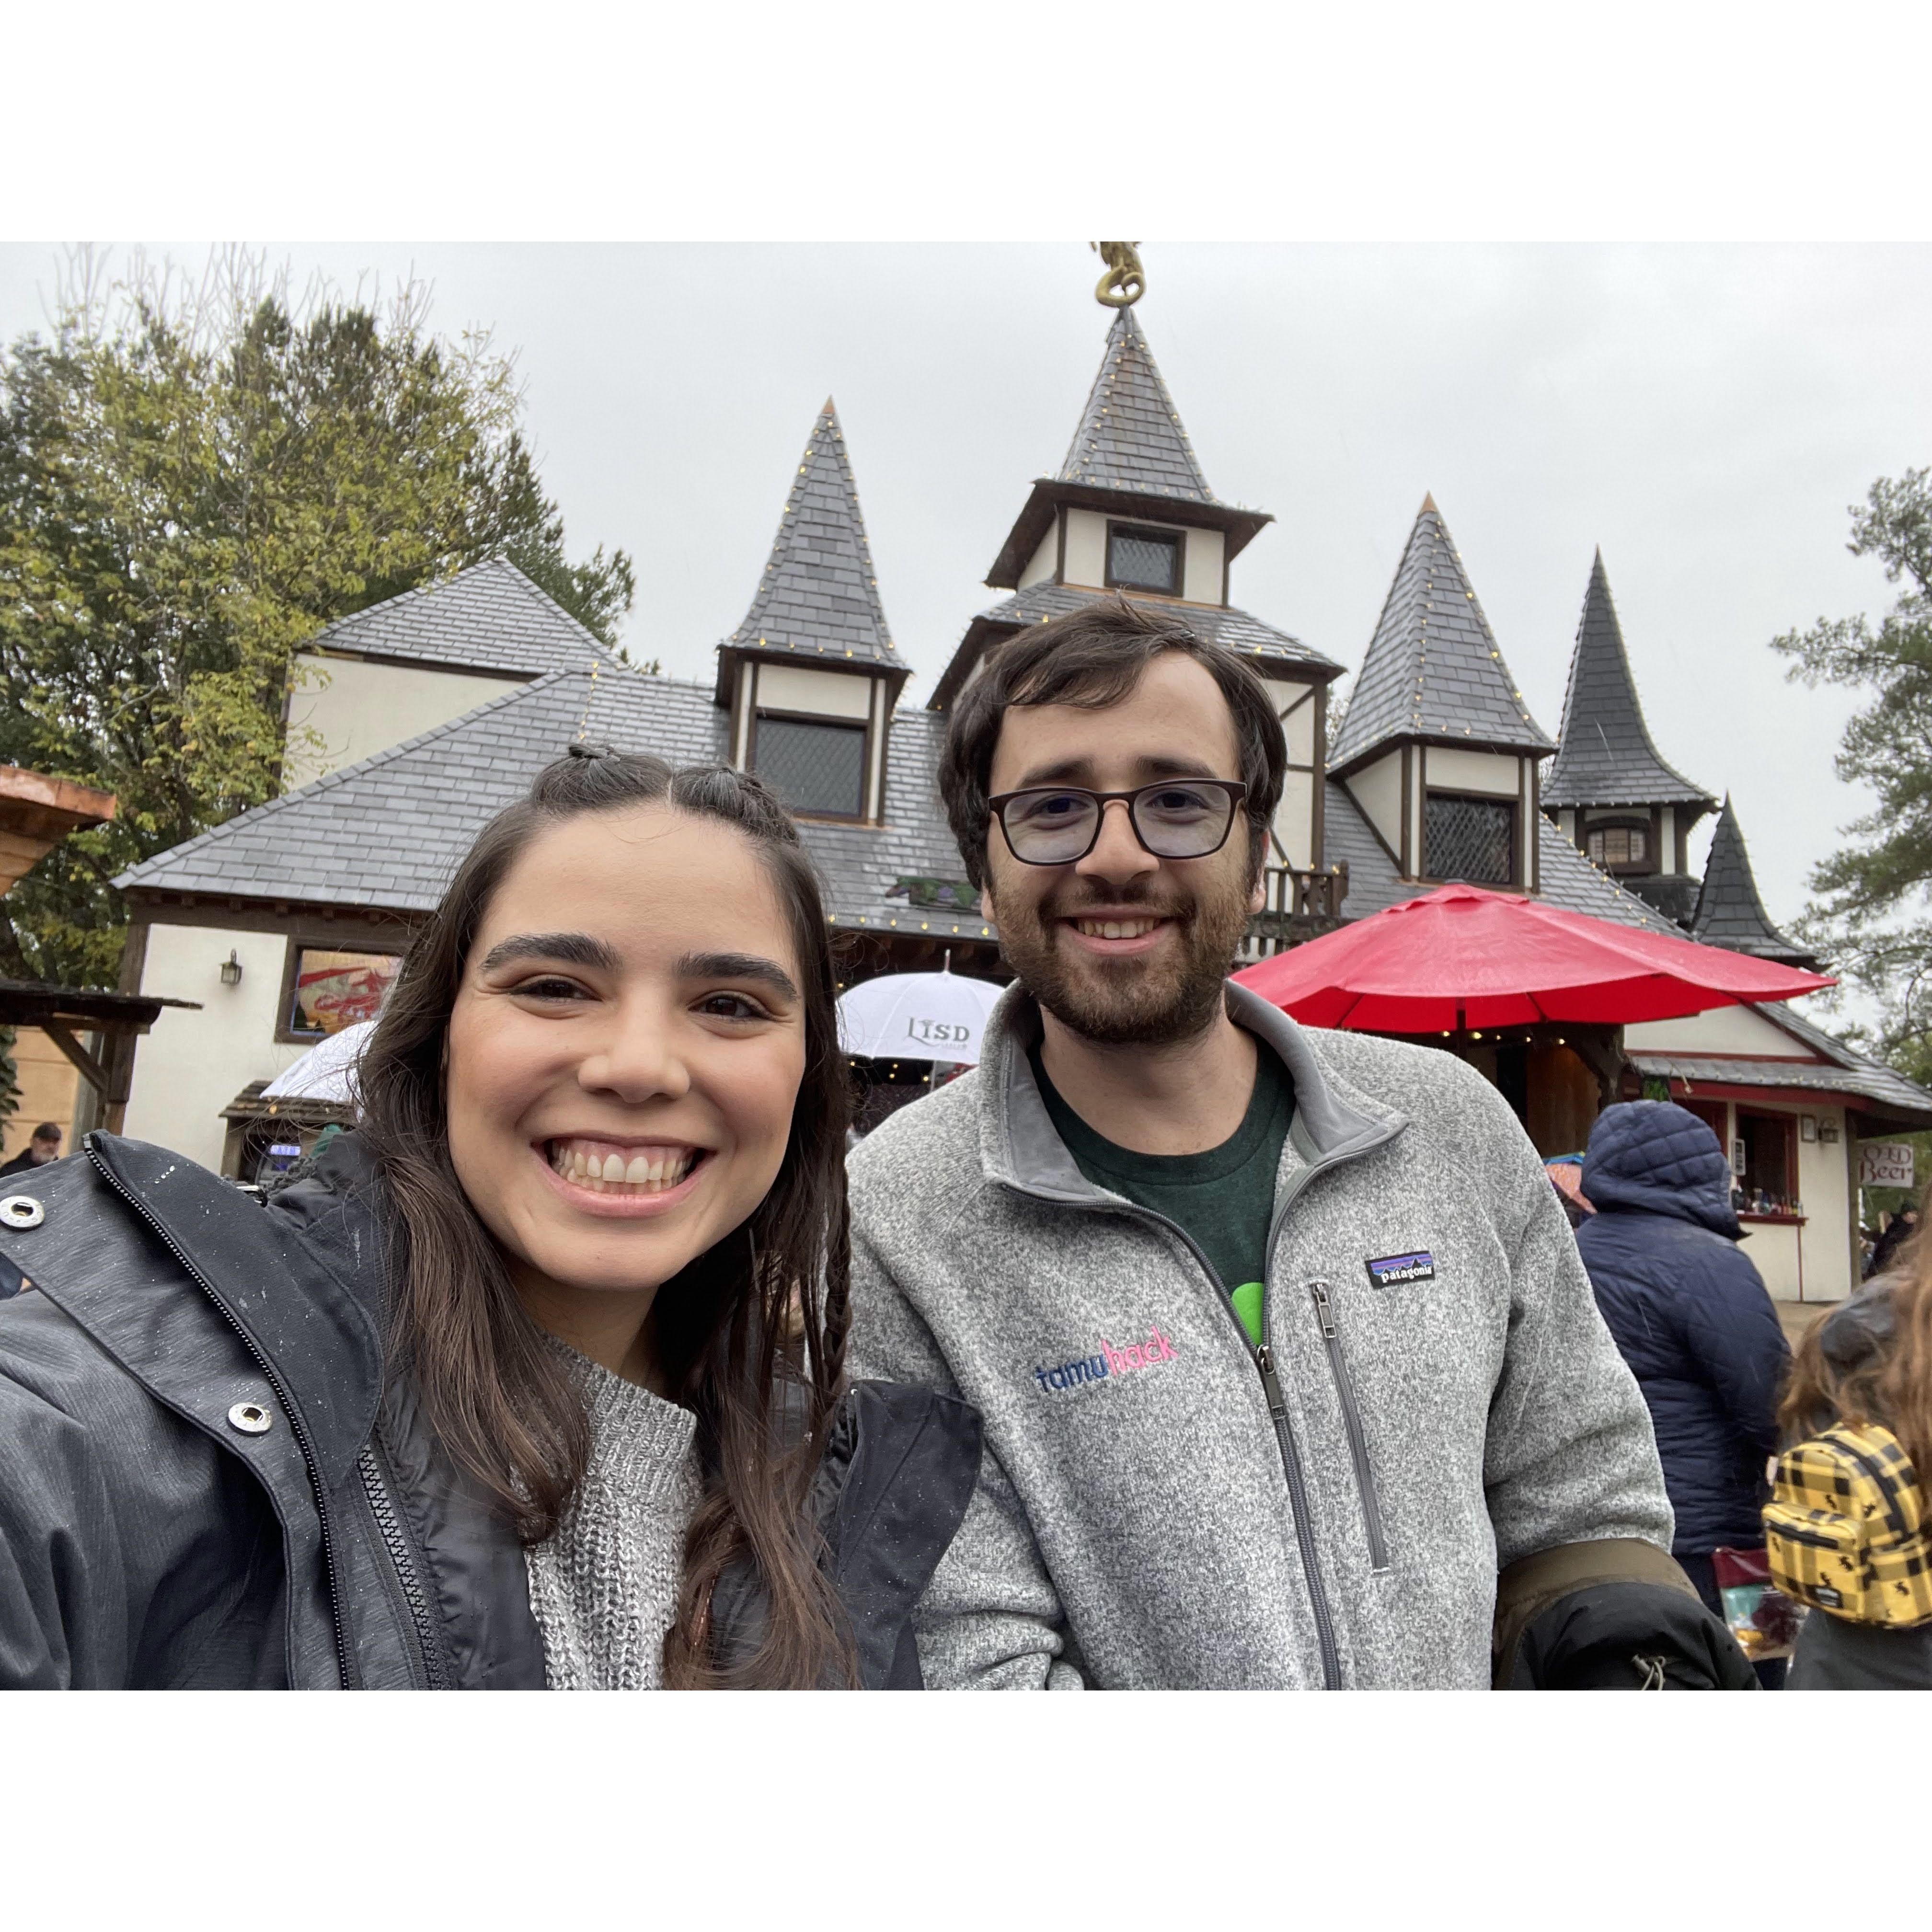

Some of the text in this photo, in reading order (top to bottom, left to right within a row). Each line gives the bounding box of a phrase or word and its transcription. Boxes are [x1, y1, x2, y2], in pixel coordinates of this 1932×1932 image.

[1860, 1160, 1912, 1183] Beer
[1381, 1264, 1432, 1284] patagonia
[1036, 1324, 1179, 1393] tamuhack
